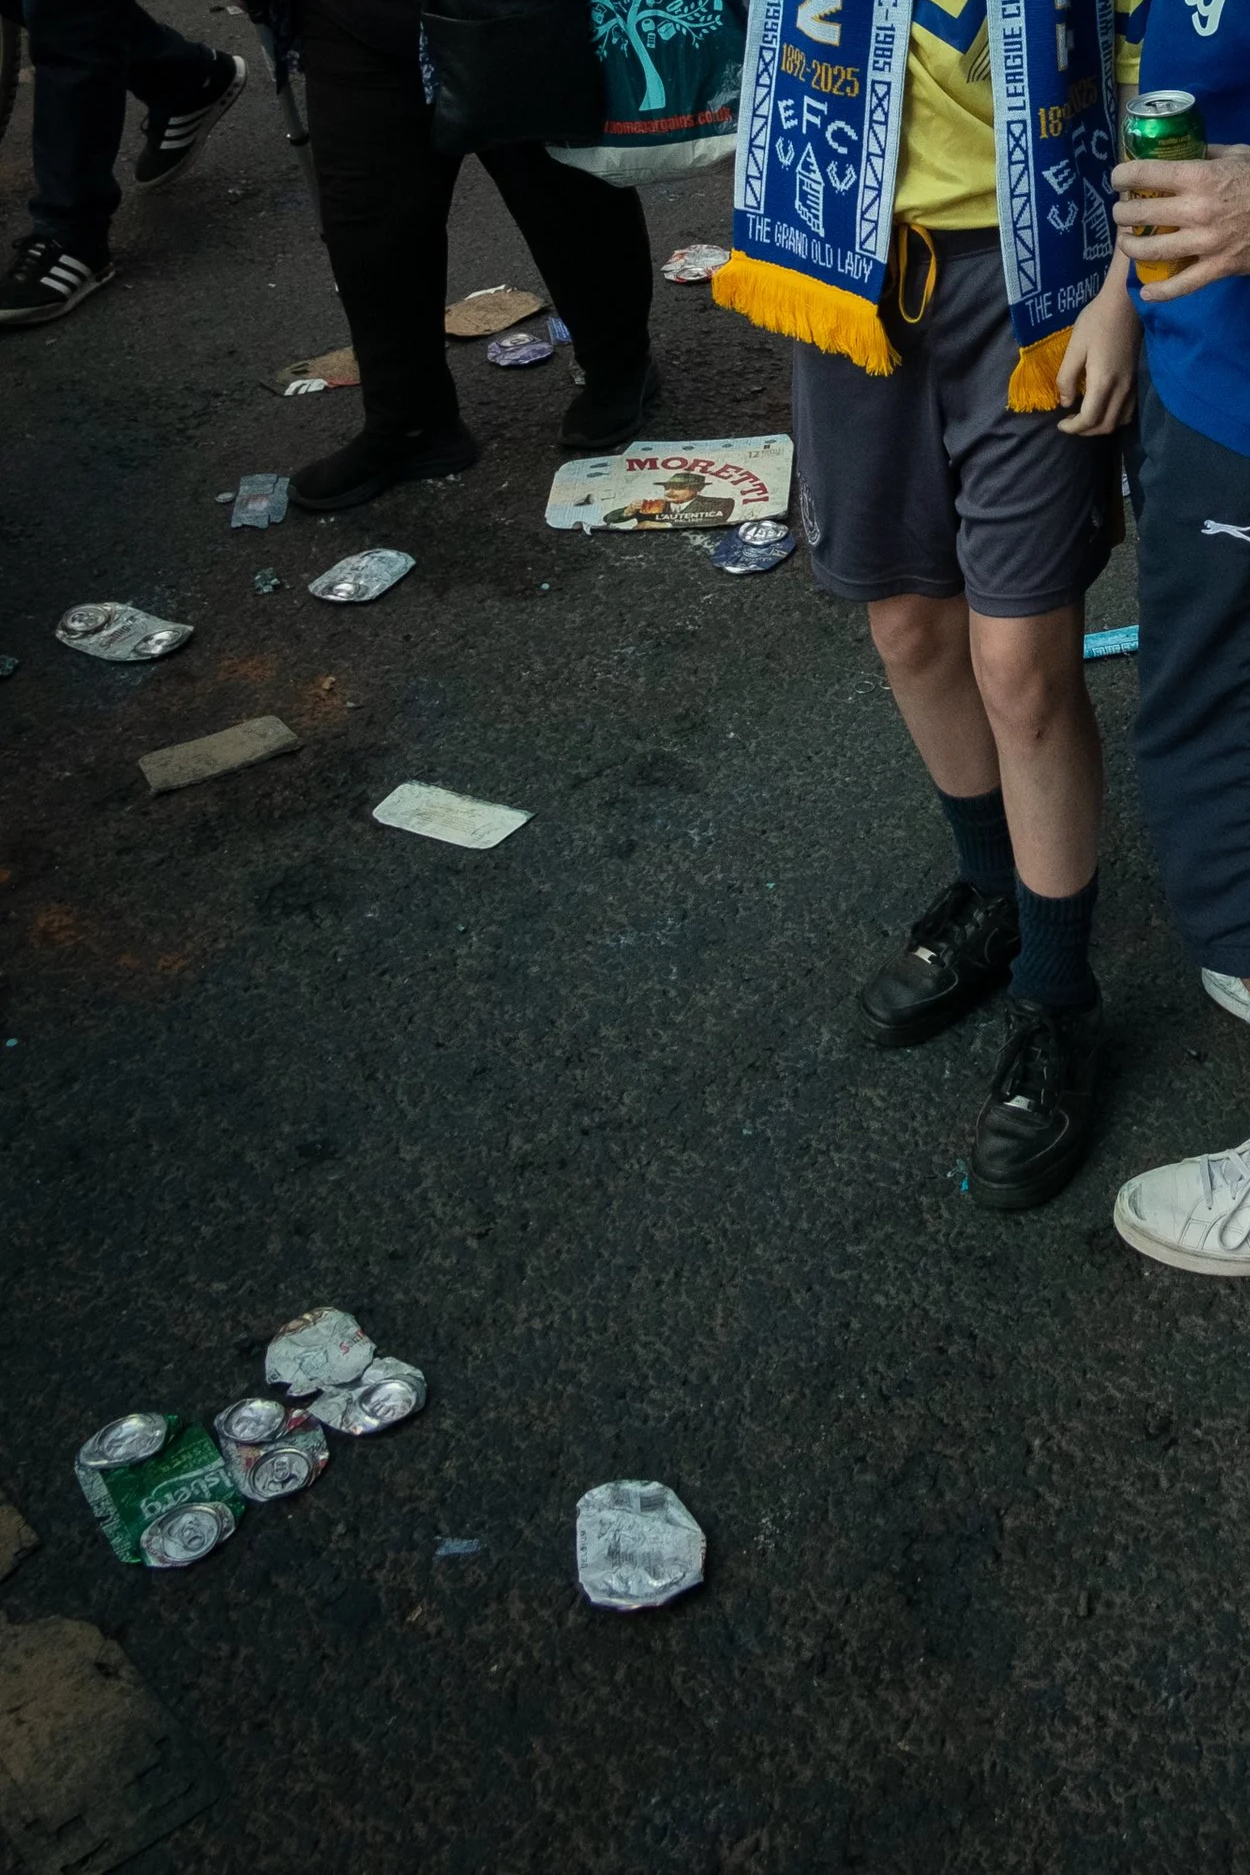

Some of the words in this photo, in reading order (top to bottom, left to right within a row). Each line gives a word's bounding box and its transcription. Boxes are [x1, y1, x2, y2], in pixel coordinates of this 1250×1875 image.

[780, 42, 860, 98] 1892-2025
[1003, 25, 1028, 114] LEAGUE
[603, 105, 733, 134] homebargains.co.uk
[746, 213, 771, 244] THE
[774, 222, 808, 259] GRAND
[811, 239, 834, 270] OLD
[837, 250, 873, 285] LADY
[1025, 291, 1053, 327] THE
[1057, 272, 1100, 312] GRAND
[625, 456, 770, 506] MORETTI
[655, 510, 725, 522] L'AUTENTICA
[141, 1468, 234, 1521] lsberg
